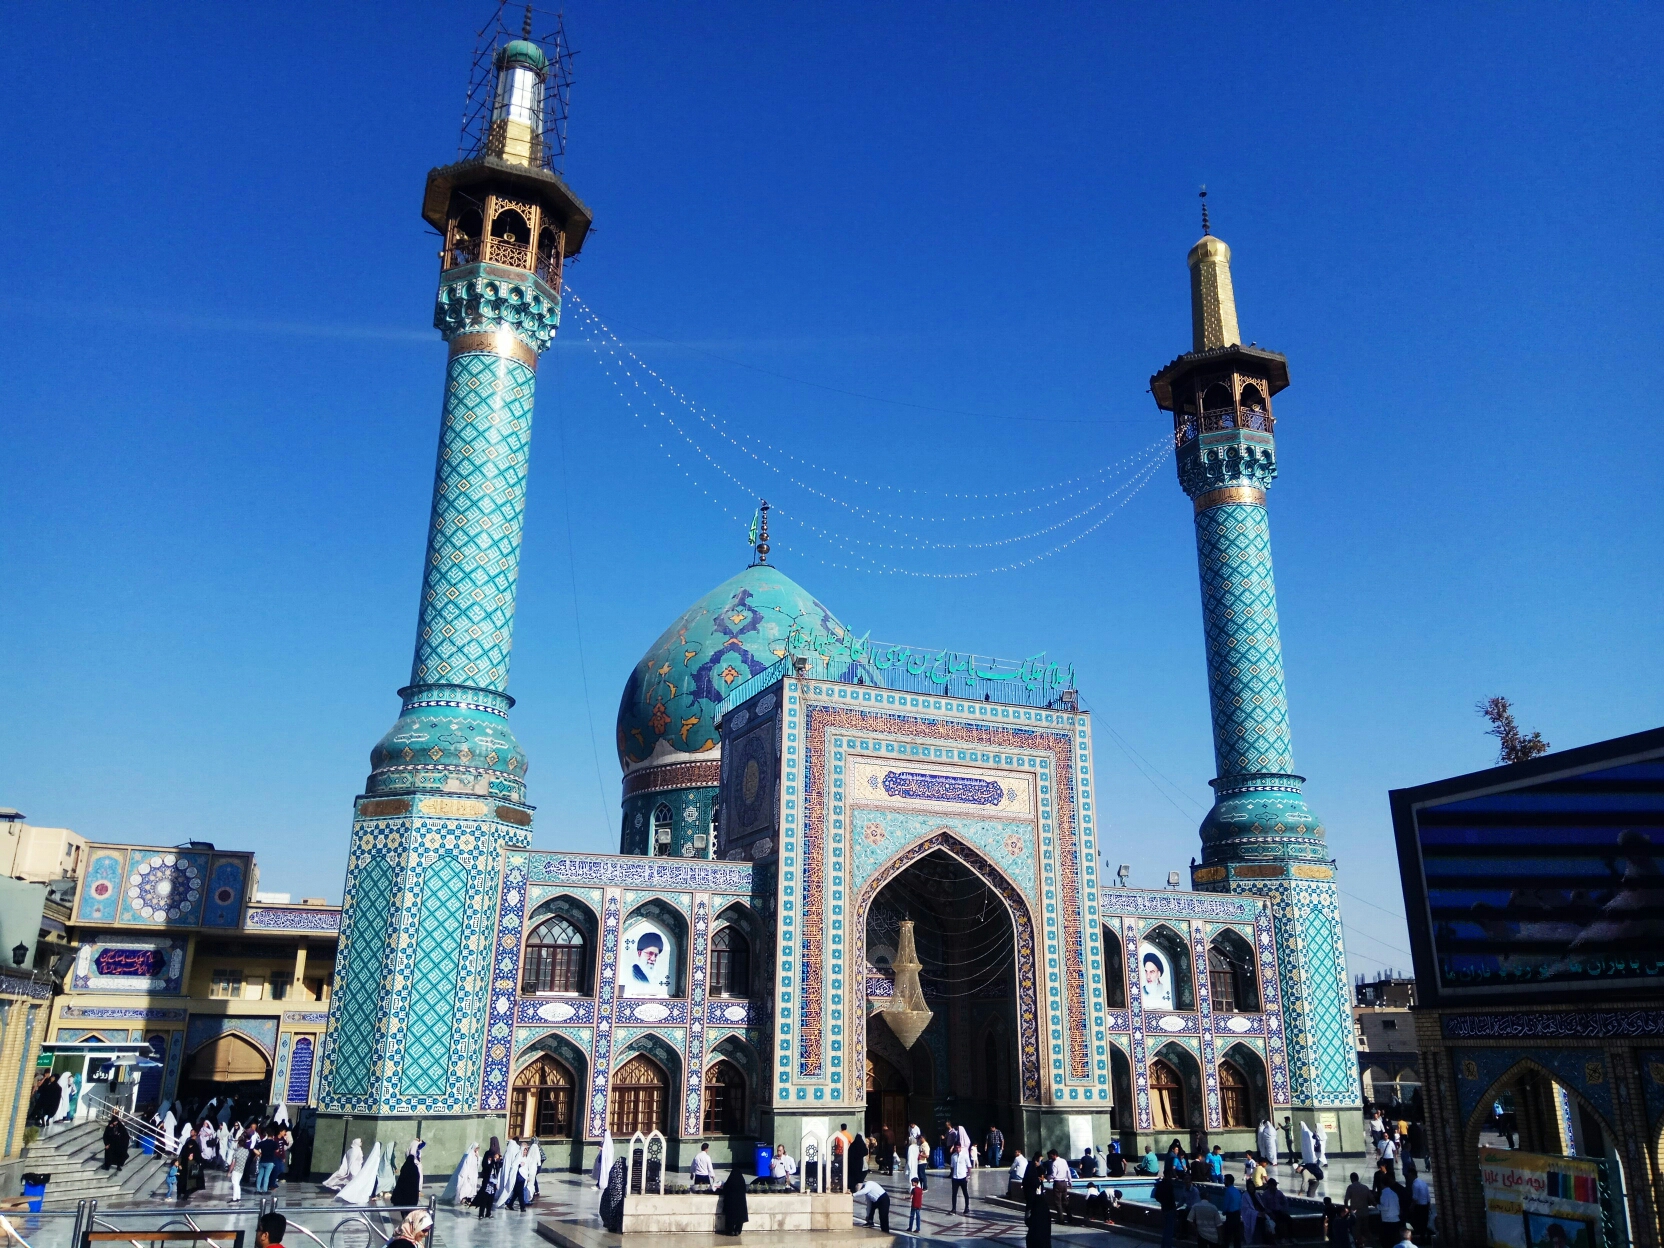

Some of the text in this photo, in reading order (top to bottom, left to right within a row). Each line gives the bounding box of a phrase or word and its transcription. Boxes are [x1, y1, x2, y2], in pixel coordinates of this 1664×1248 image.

[931, 648, 966, 684] صالح
[1043, 661, 1076, 698] السلام
[92, 1070, 108, 1079] رواق
[1484, 1170, 1499, 1185] عزیز
[1526, 1177, 1545, 1192] بچه
